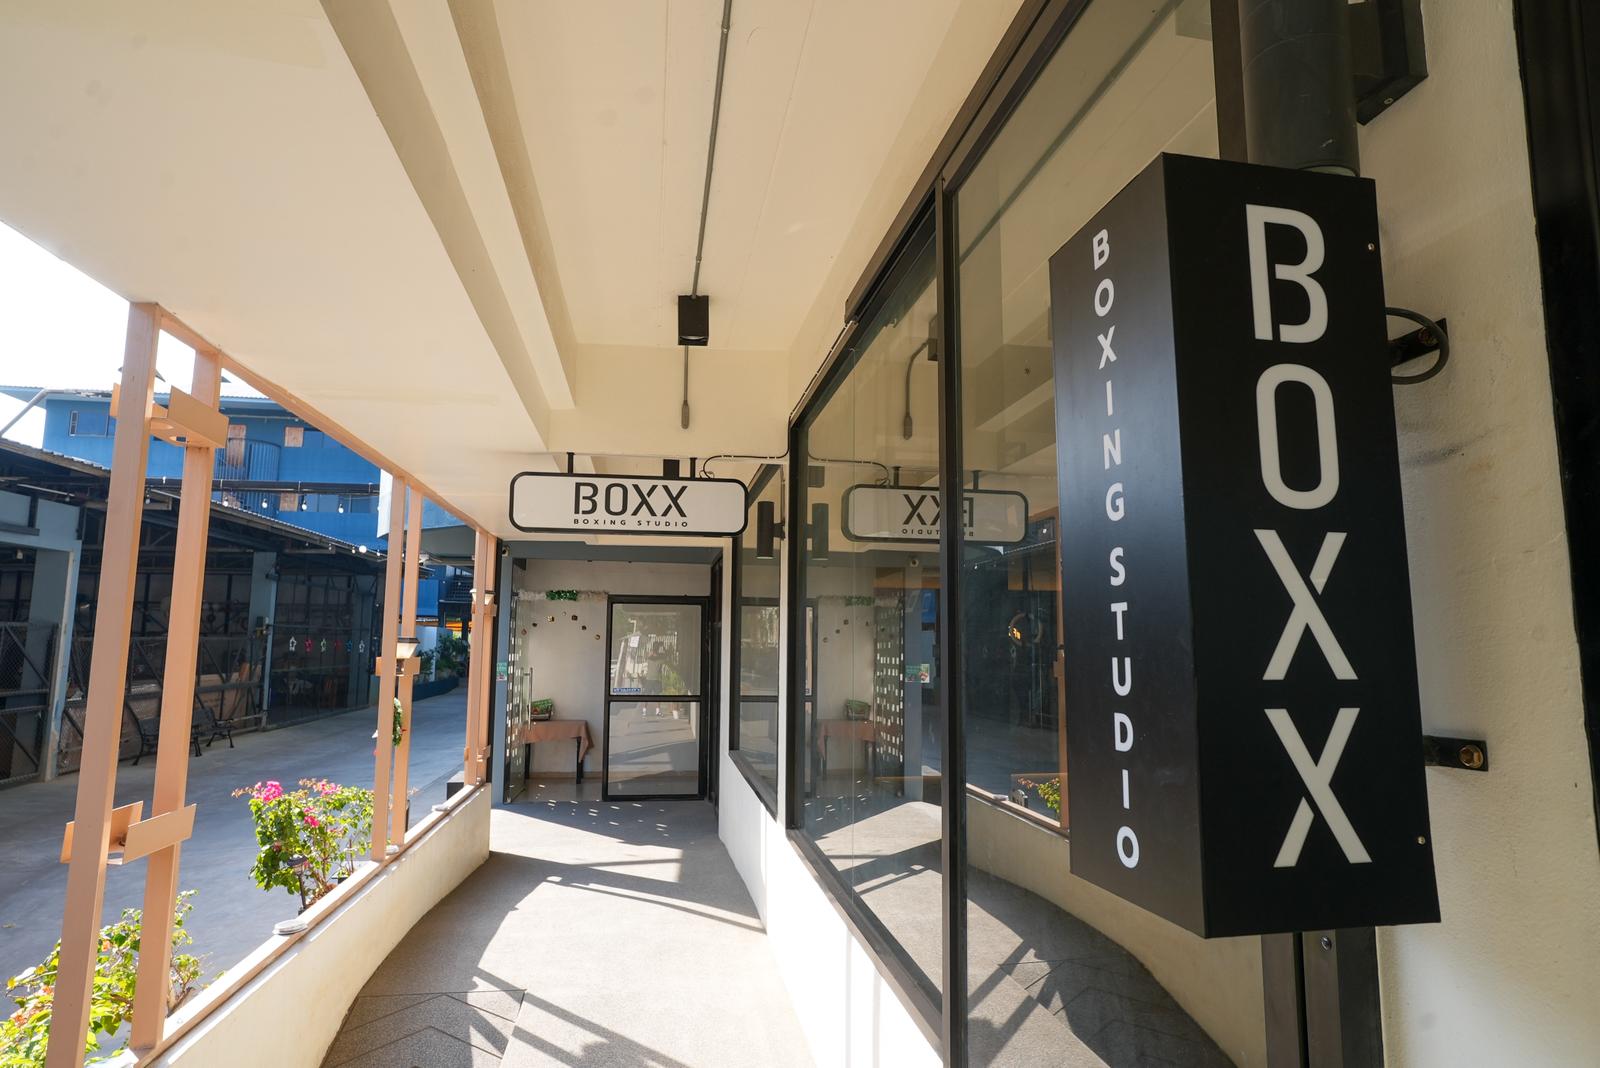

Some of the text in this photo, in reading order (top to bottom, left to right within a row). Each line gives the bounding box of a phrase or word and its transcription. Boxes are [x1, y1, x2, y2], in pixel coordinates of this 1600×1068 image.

[573, 518, 688, 528] BOXING STUDIO
[574, 482, 688, 518] BOXX
[1093, 229, 1140, 869] BOXING STUDIO
[1245, 204, 1372, 868] BOXX
